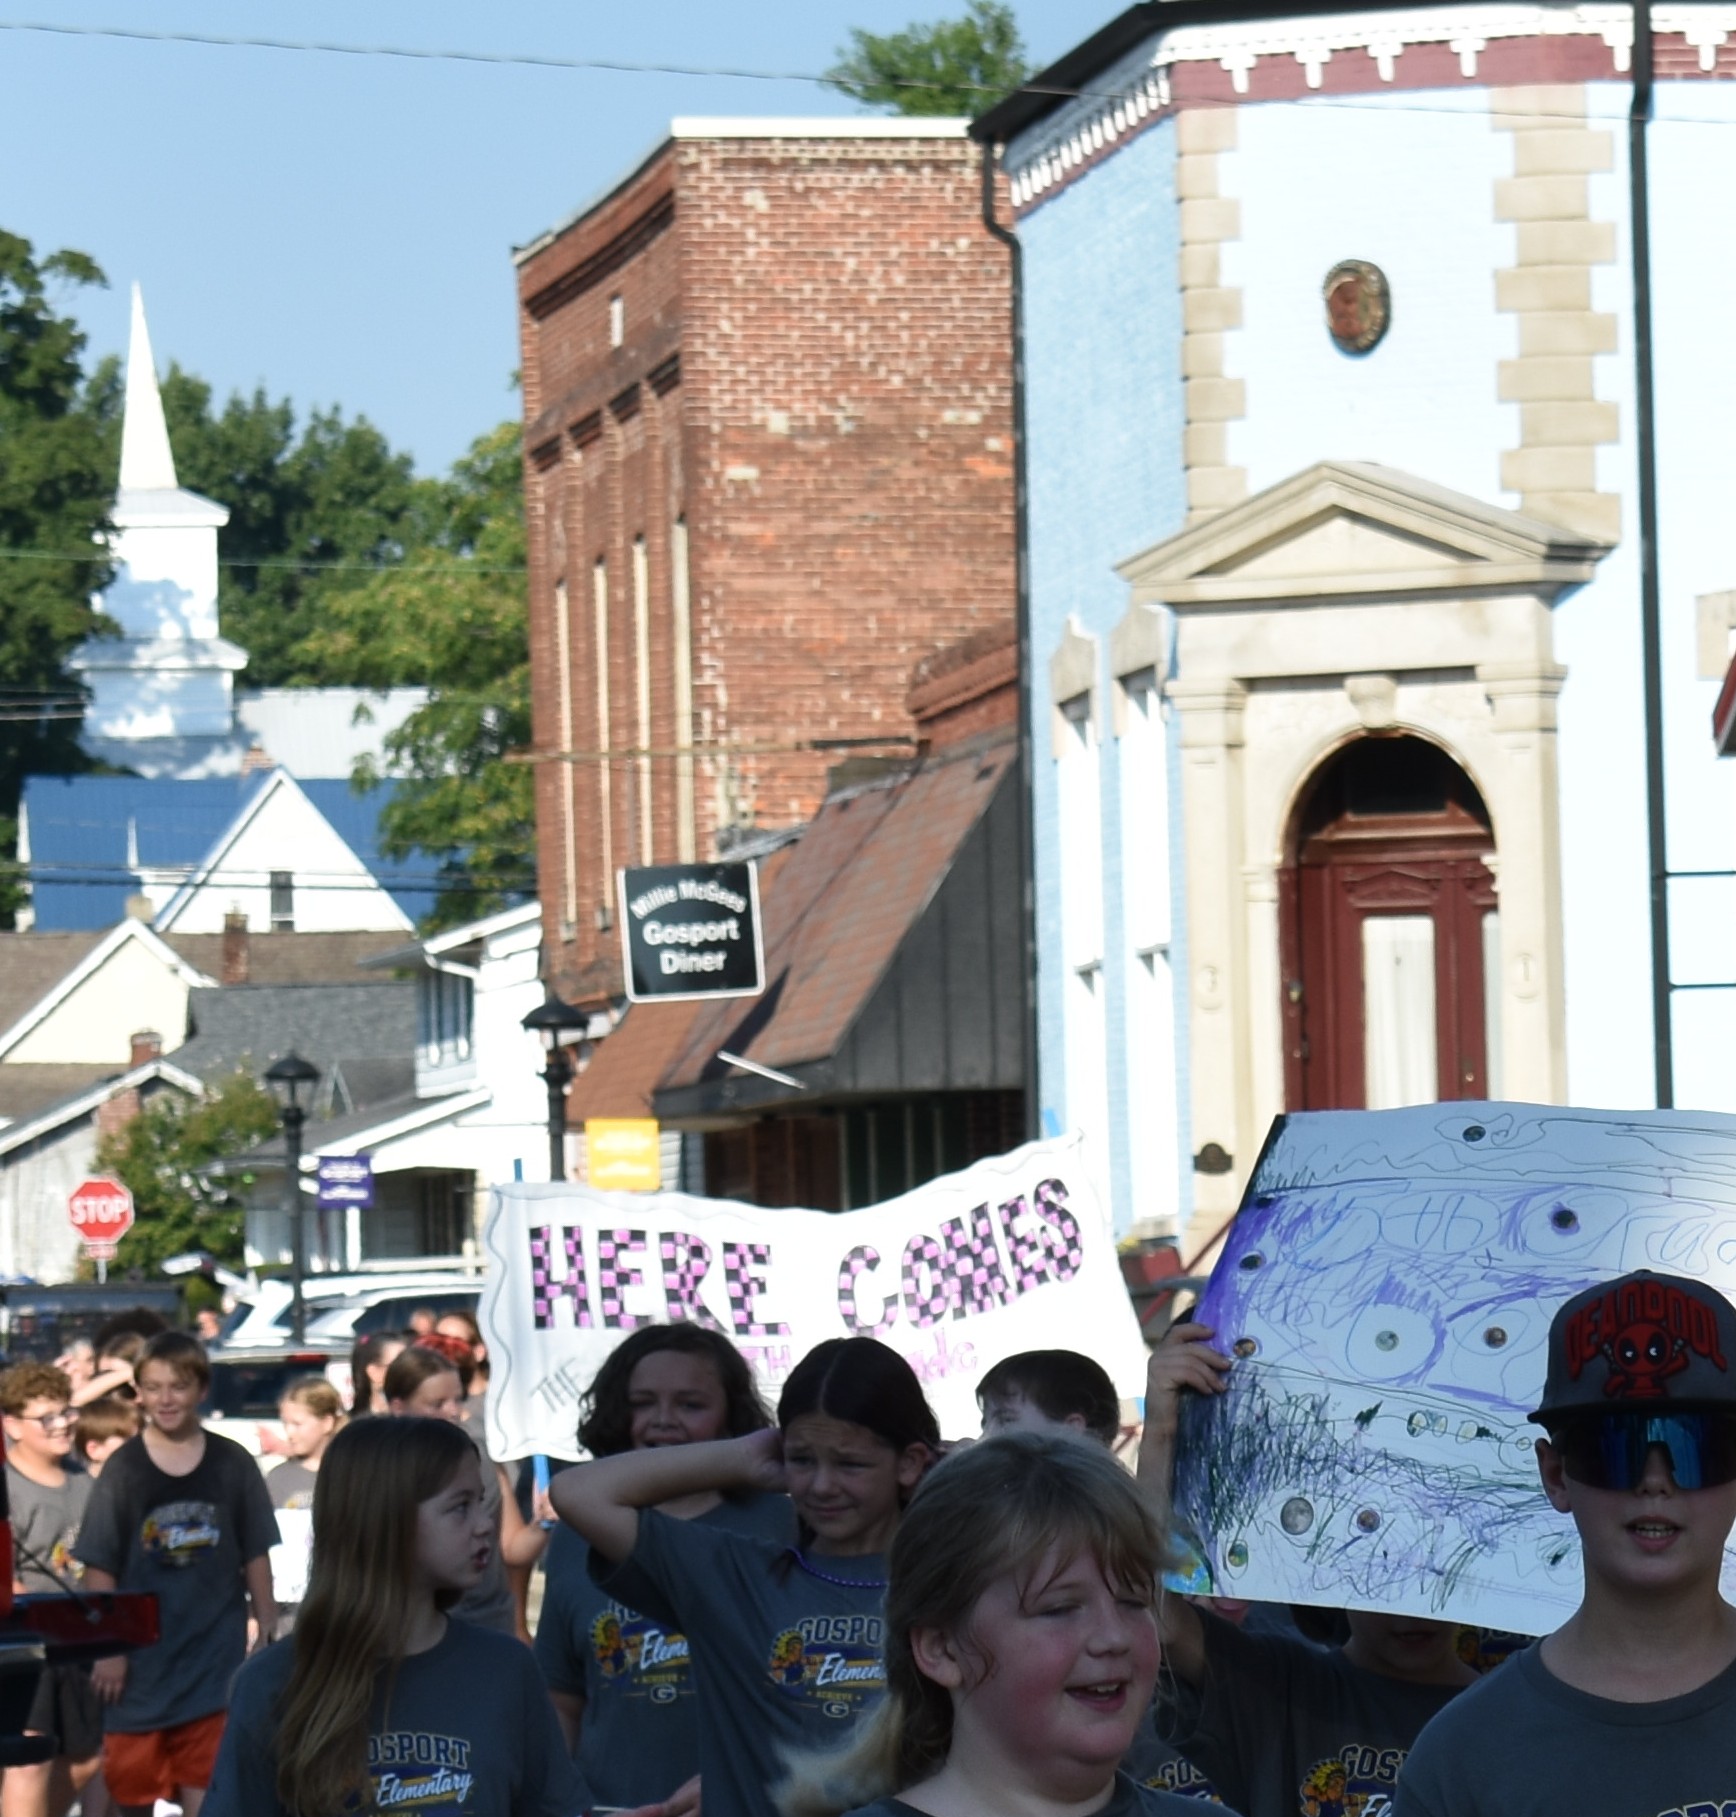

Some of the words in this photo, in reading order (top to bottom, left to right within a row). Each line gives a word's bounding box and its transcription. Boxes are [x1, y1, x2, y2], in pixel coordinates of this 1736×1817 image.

[642, 917, 741, 946] Gosport
[660, 949, 727, 975] Diner
[71, 1195, 129, 1224] STOP
[529, 1225, 792, 1336] HERE
[837, 1178, 1083, 1337] COMES
[376, 1767, 474, 1807] Elementary
